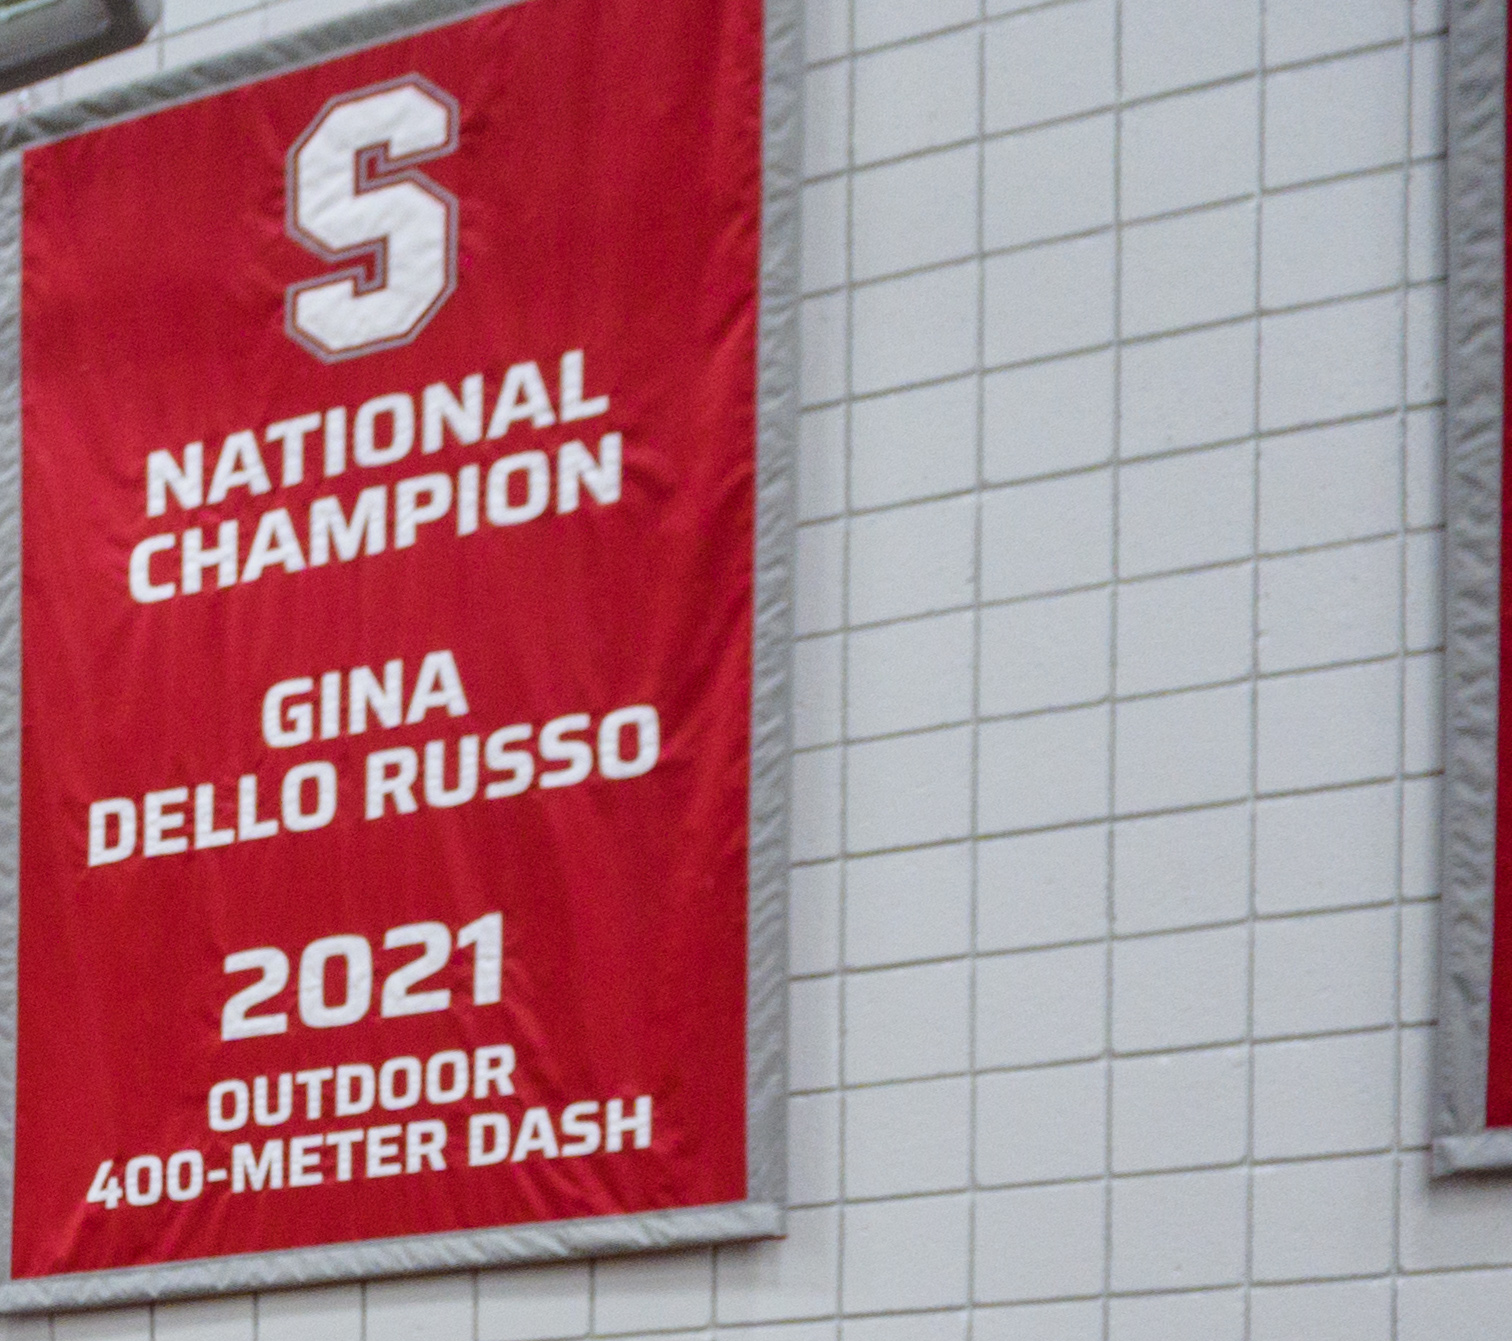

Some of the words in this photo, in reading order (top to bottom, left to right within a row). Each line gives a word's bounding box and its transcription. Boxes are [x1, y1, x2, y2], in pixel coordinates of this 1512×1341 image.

[284, 72, 458, 363] S
[145, 348, 610, 518] NATIONAL
[127, 431, 622, 604] CHAMPION
[260, 648, 469, 749] GINA
[87, 759, 338, 867] DELLO
[364, 703, 660, 821] RUSSO
[219, 911, 503, 1041] 2021
[85, 1118, 448, 1210] 400-METER
[467, 1094, 652, 1167] DASH
[207, 1043, 516, 1132] OUTDOOR
